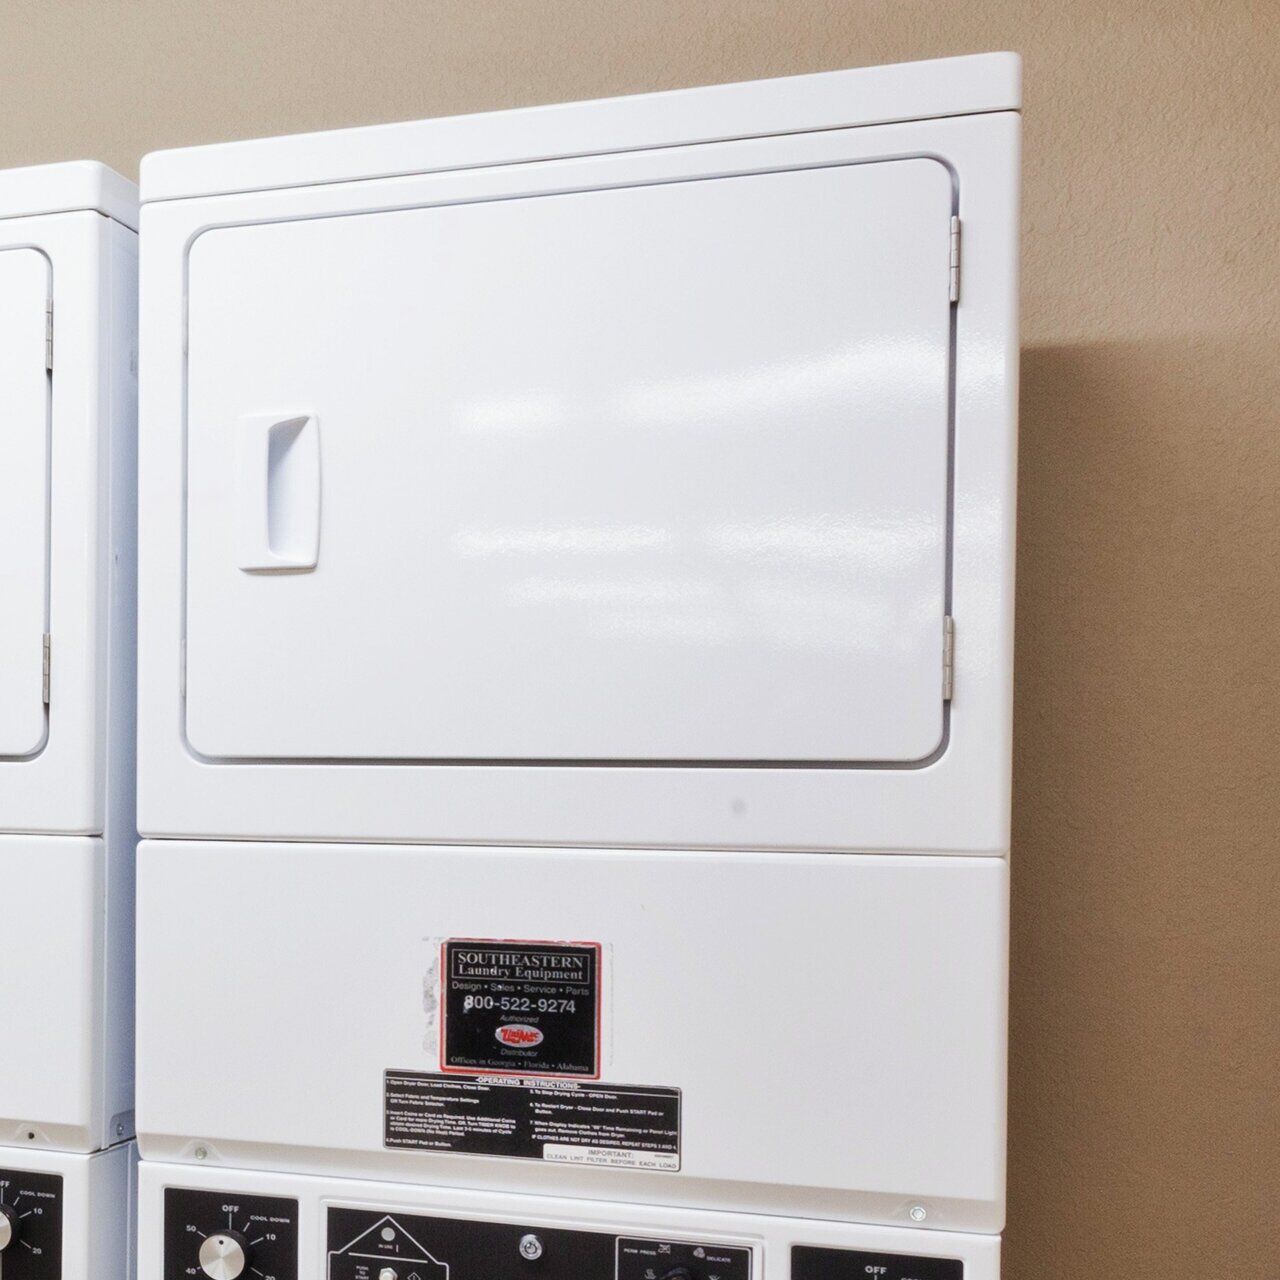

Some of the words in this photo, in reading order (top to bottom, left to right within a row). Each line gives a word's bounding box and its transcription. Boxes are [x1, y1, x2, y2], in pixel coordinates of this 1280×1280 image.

[458, 952, 583, 968] SOUTHEASTERN
[458, 964, 511, 978] Laundry
[516, 966, 583, 981] Equipment
[452, 981, 482, 992] Design
[491, 982, 515, 992] Sales
[524, 984, 557, 994] Service
[566, 986, 589, 996] Parts
[464, 995, 576, 1013] 800-522-9274
[500, 1014, 539, 1023] Authorized
[37, 1191, 56, 1199] DOWN
[222, 1204, 240, 1213] OFF
[32, 1247, 42, 1255] 20
[865, 1265, 887, 1275] OFF
